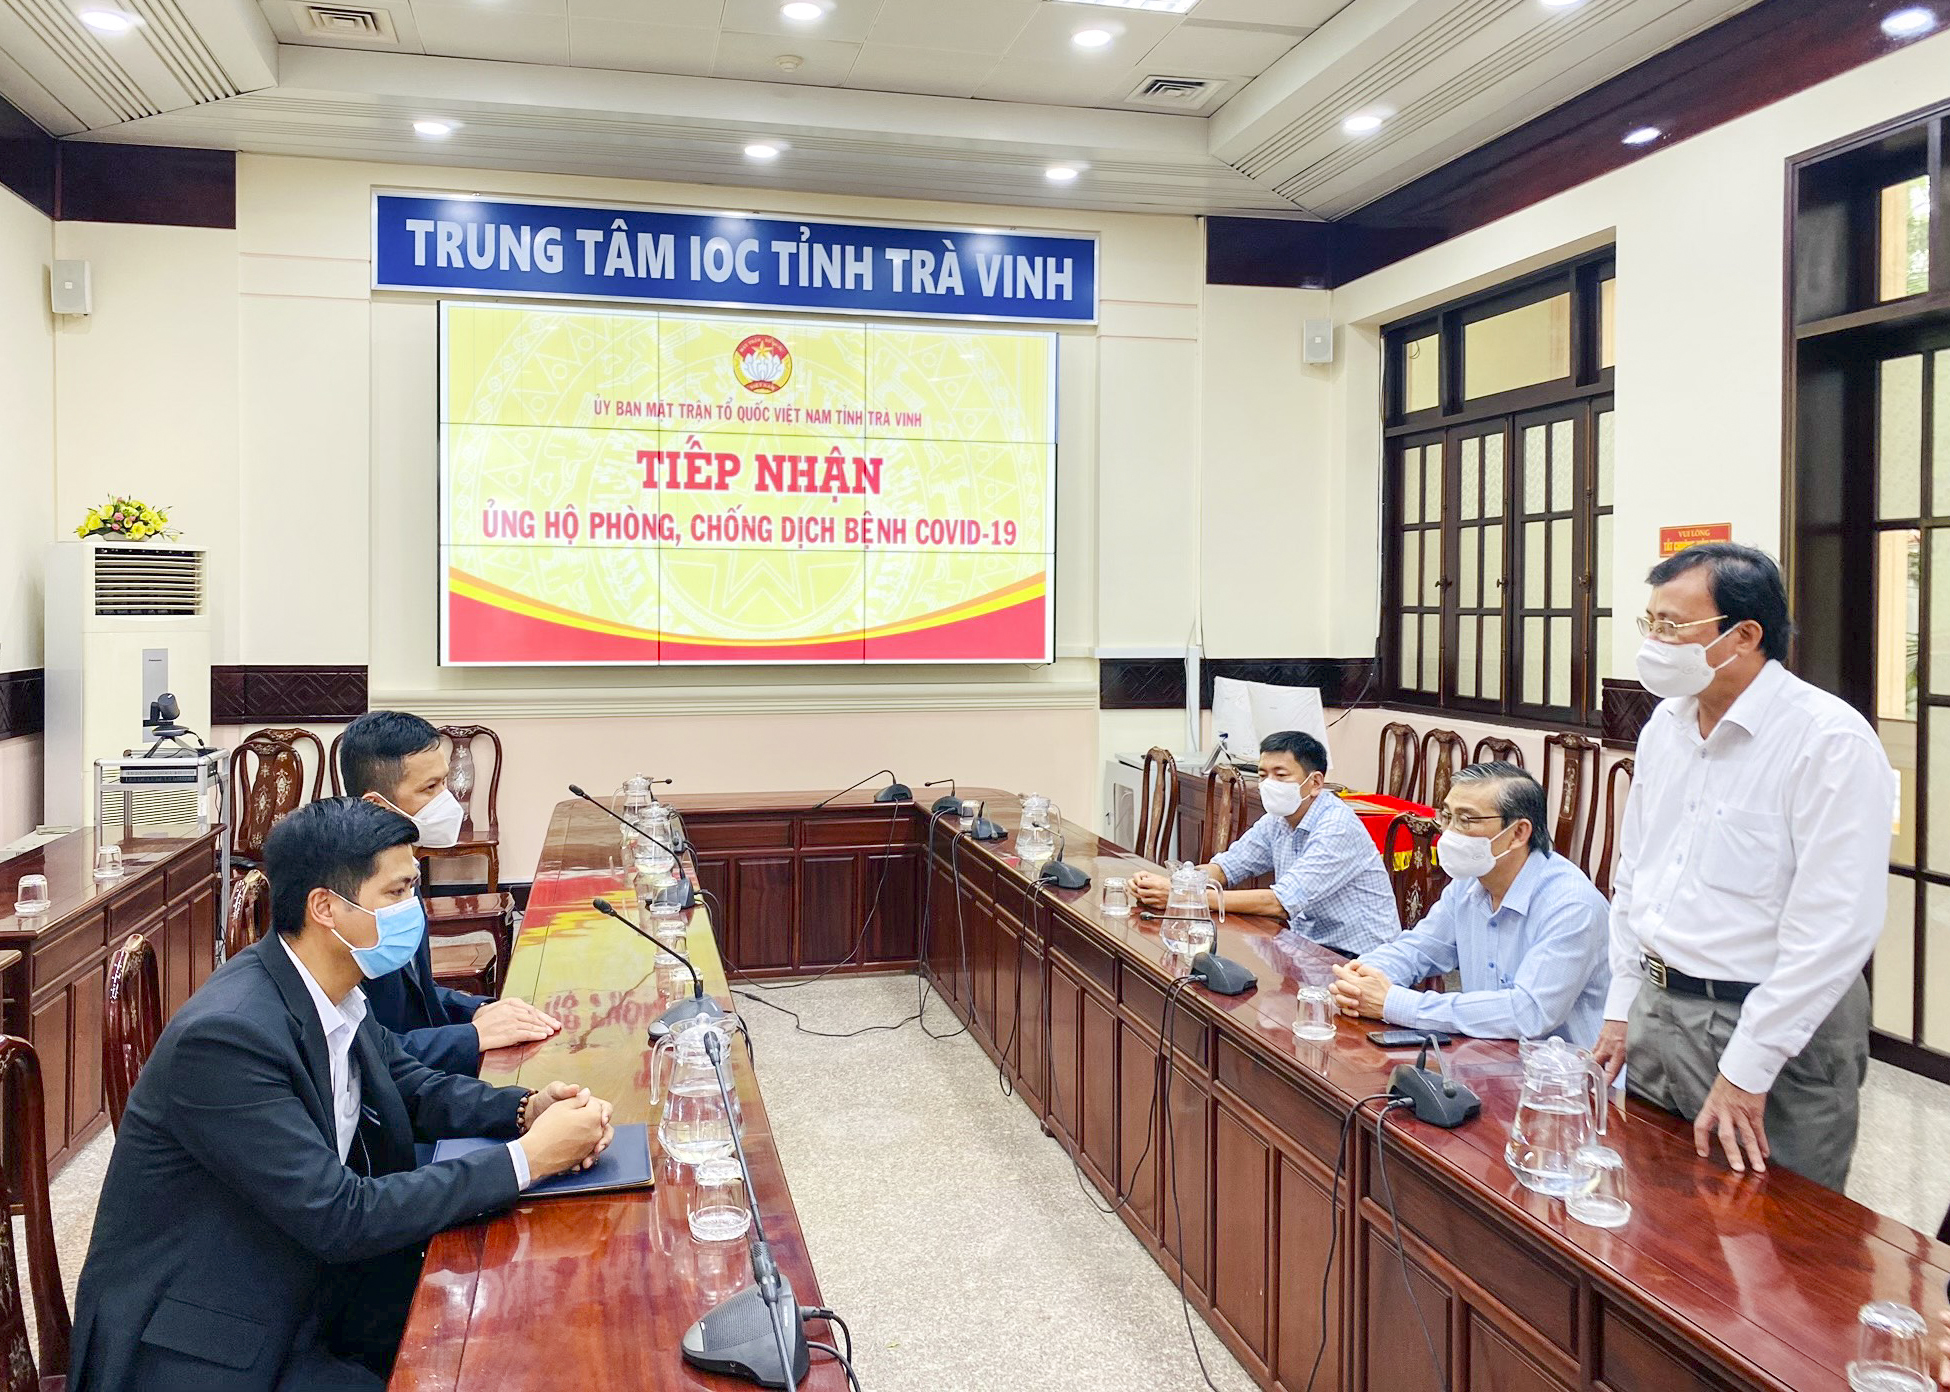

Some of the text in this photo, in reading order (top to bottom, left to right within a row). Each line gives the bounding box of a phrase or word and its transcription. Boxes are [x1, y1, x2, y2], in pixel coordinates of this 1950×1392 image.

[405, 218, 1073, 301] TRUNG TÂM IOC TỈNH TRÀ VINH
[594, 394, 611, 416] ỦY
[616, 401, 641, 417] BAN
[678, 399, 712, 424] TRẬN
[716, 397, 733, 421] TỔ
[737, 400, 770, 423] QUỐC
[774, 403, 801, 427] VIỆT
[805, 408, 832, 425] NAM
[836, 405, 863, 426] TỈNH
[895, 412, 922, 428] VINH
[636, 434, 884, 504] TIẾP NHẬN
[482, 498, 1017, 550] ỦNG HỘ PHÒNG, CHỐNG DỊCH BỆNH COVID-19
